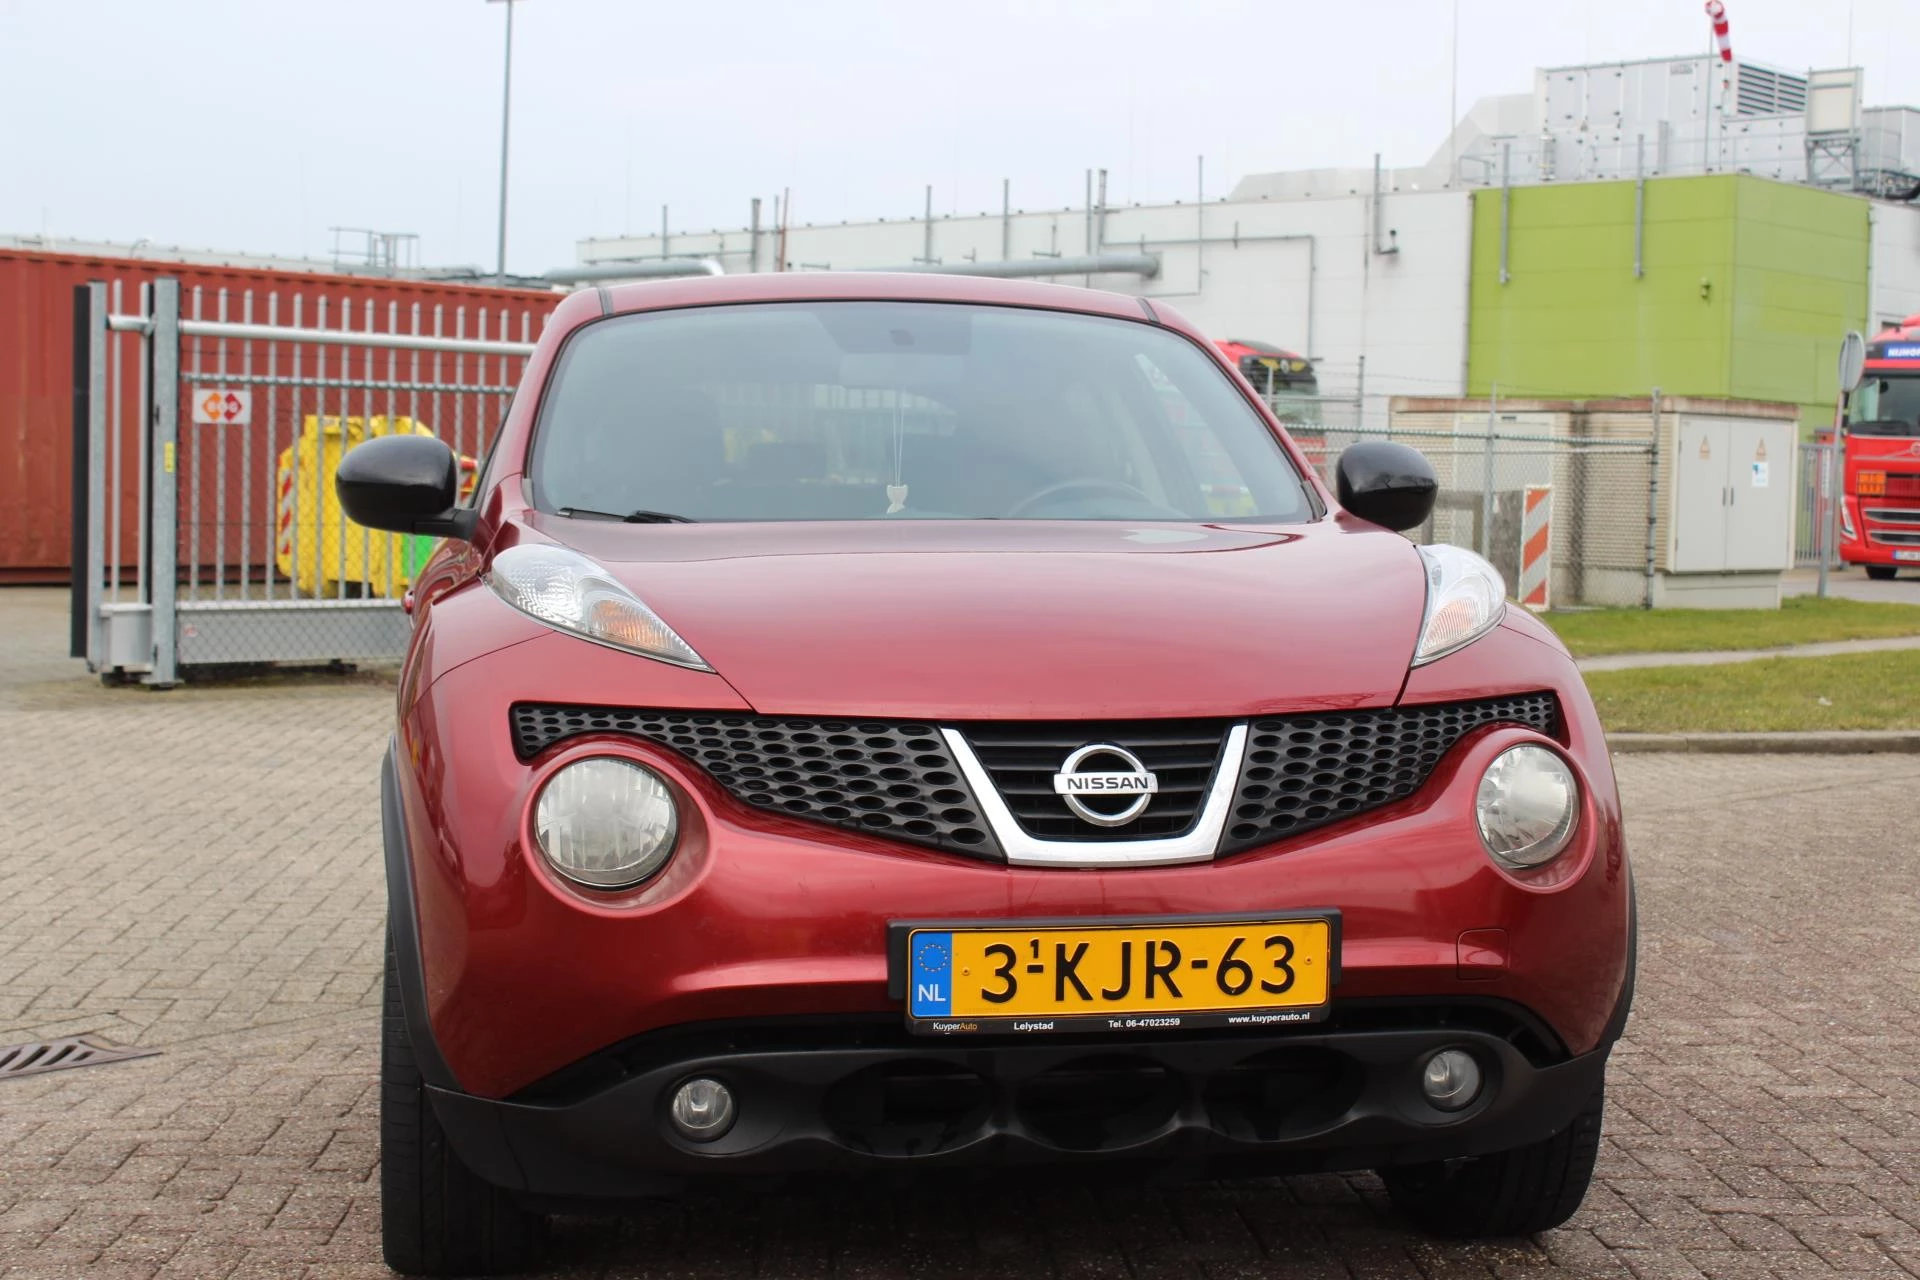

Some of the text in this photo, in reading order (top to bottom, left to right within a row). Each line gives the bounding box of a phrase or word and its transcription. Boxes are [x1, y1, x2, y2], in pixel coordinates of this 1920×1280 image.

[1067, 777, 1148, 790] NISSAN
[918, 984, 946, 1002] NL
[933, 1012, 1310, 1032] KuyperAuto Lelystad Tel. 06-47023259 www.kuyperauto.nl
